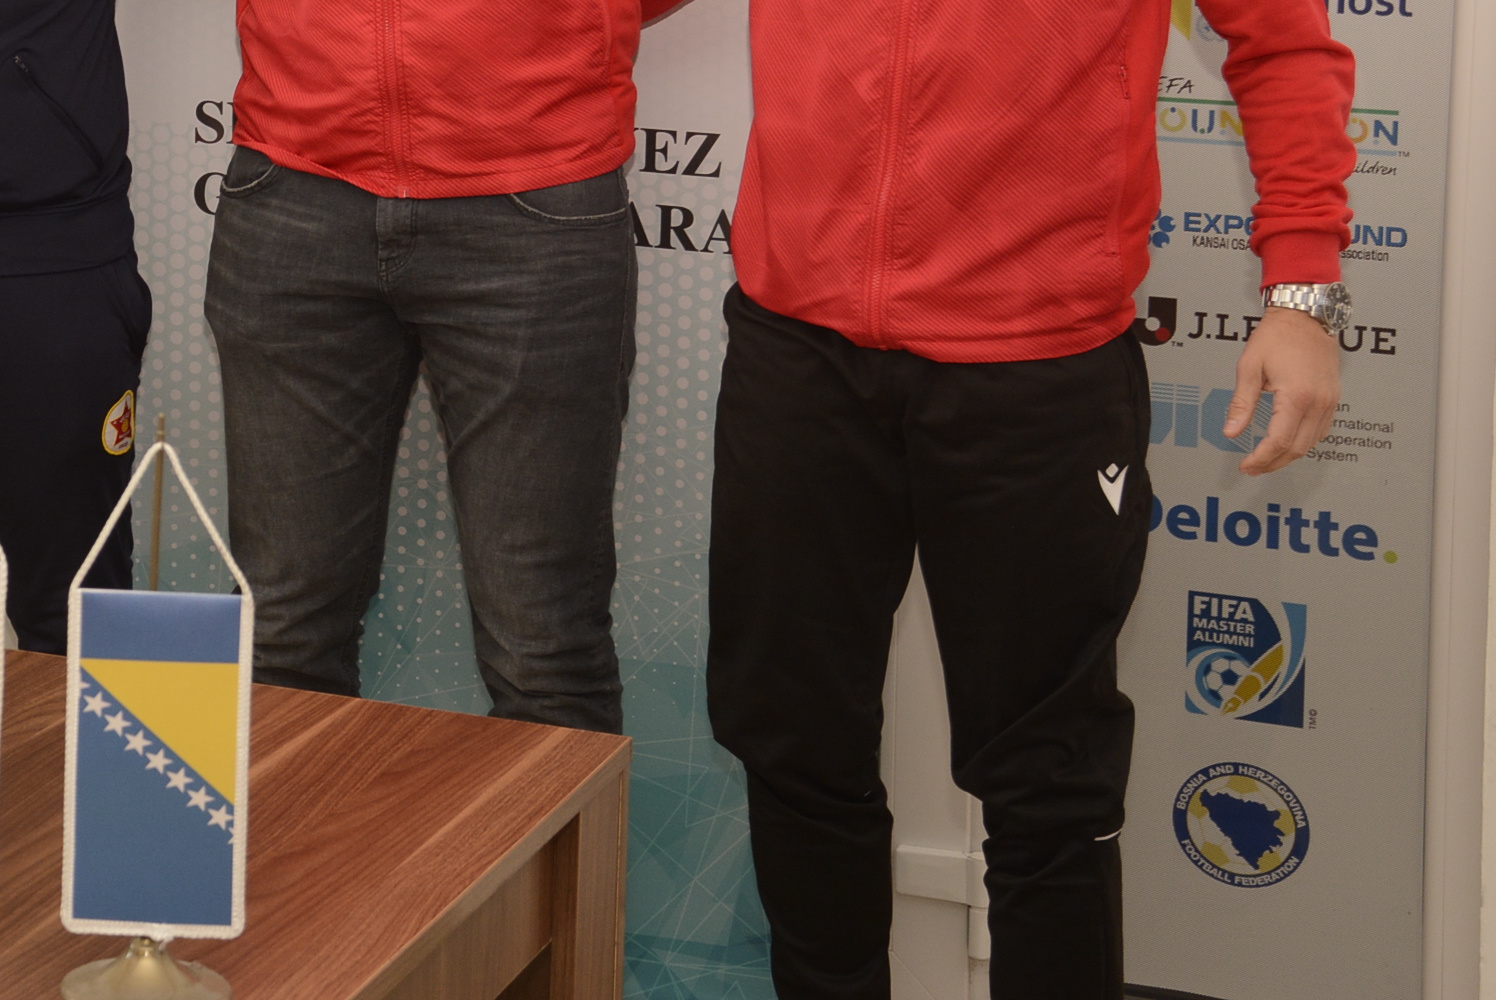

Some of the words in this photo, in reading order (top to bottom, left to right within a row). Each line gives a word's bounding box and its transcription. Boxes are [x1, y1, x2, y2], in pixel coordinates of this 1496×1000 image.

[634, 128, 722, 178] EZ
[1350, 160, 1397, 175] ildren
[1192, 235, 1230, 250] KANSAI
[1351, 224, 1408, 248] UND
[1340, 250, 1389, 261] ssociation
[1306, 447, 1358, 461] System
[1193, 595, 1255, 622] FIFA
[1193, 618, 1255, 634] MASTER
[1193, 630, 1254, 648] ALUMNI
[1176, 774, 1208, 810] BOSNIA
[1208, 764, 1234, 778] AND
[1238, 765, 1306, 828] HERZEGOVINA
[1181, 839, 1232, 883] FOOTBALL
[1234, 856, 1300, 886] FEDERATION
